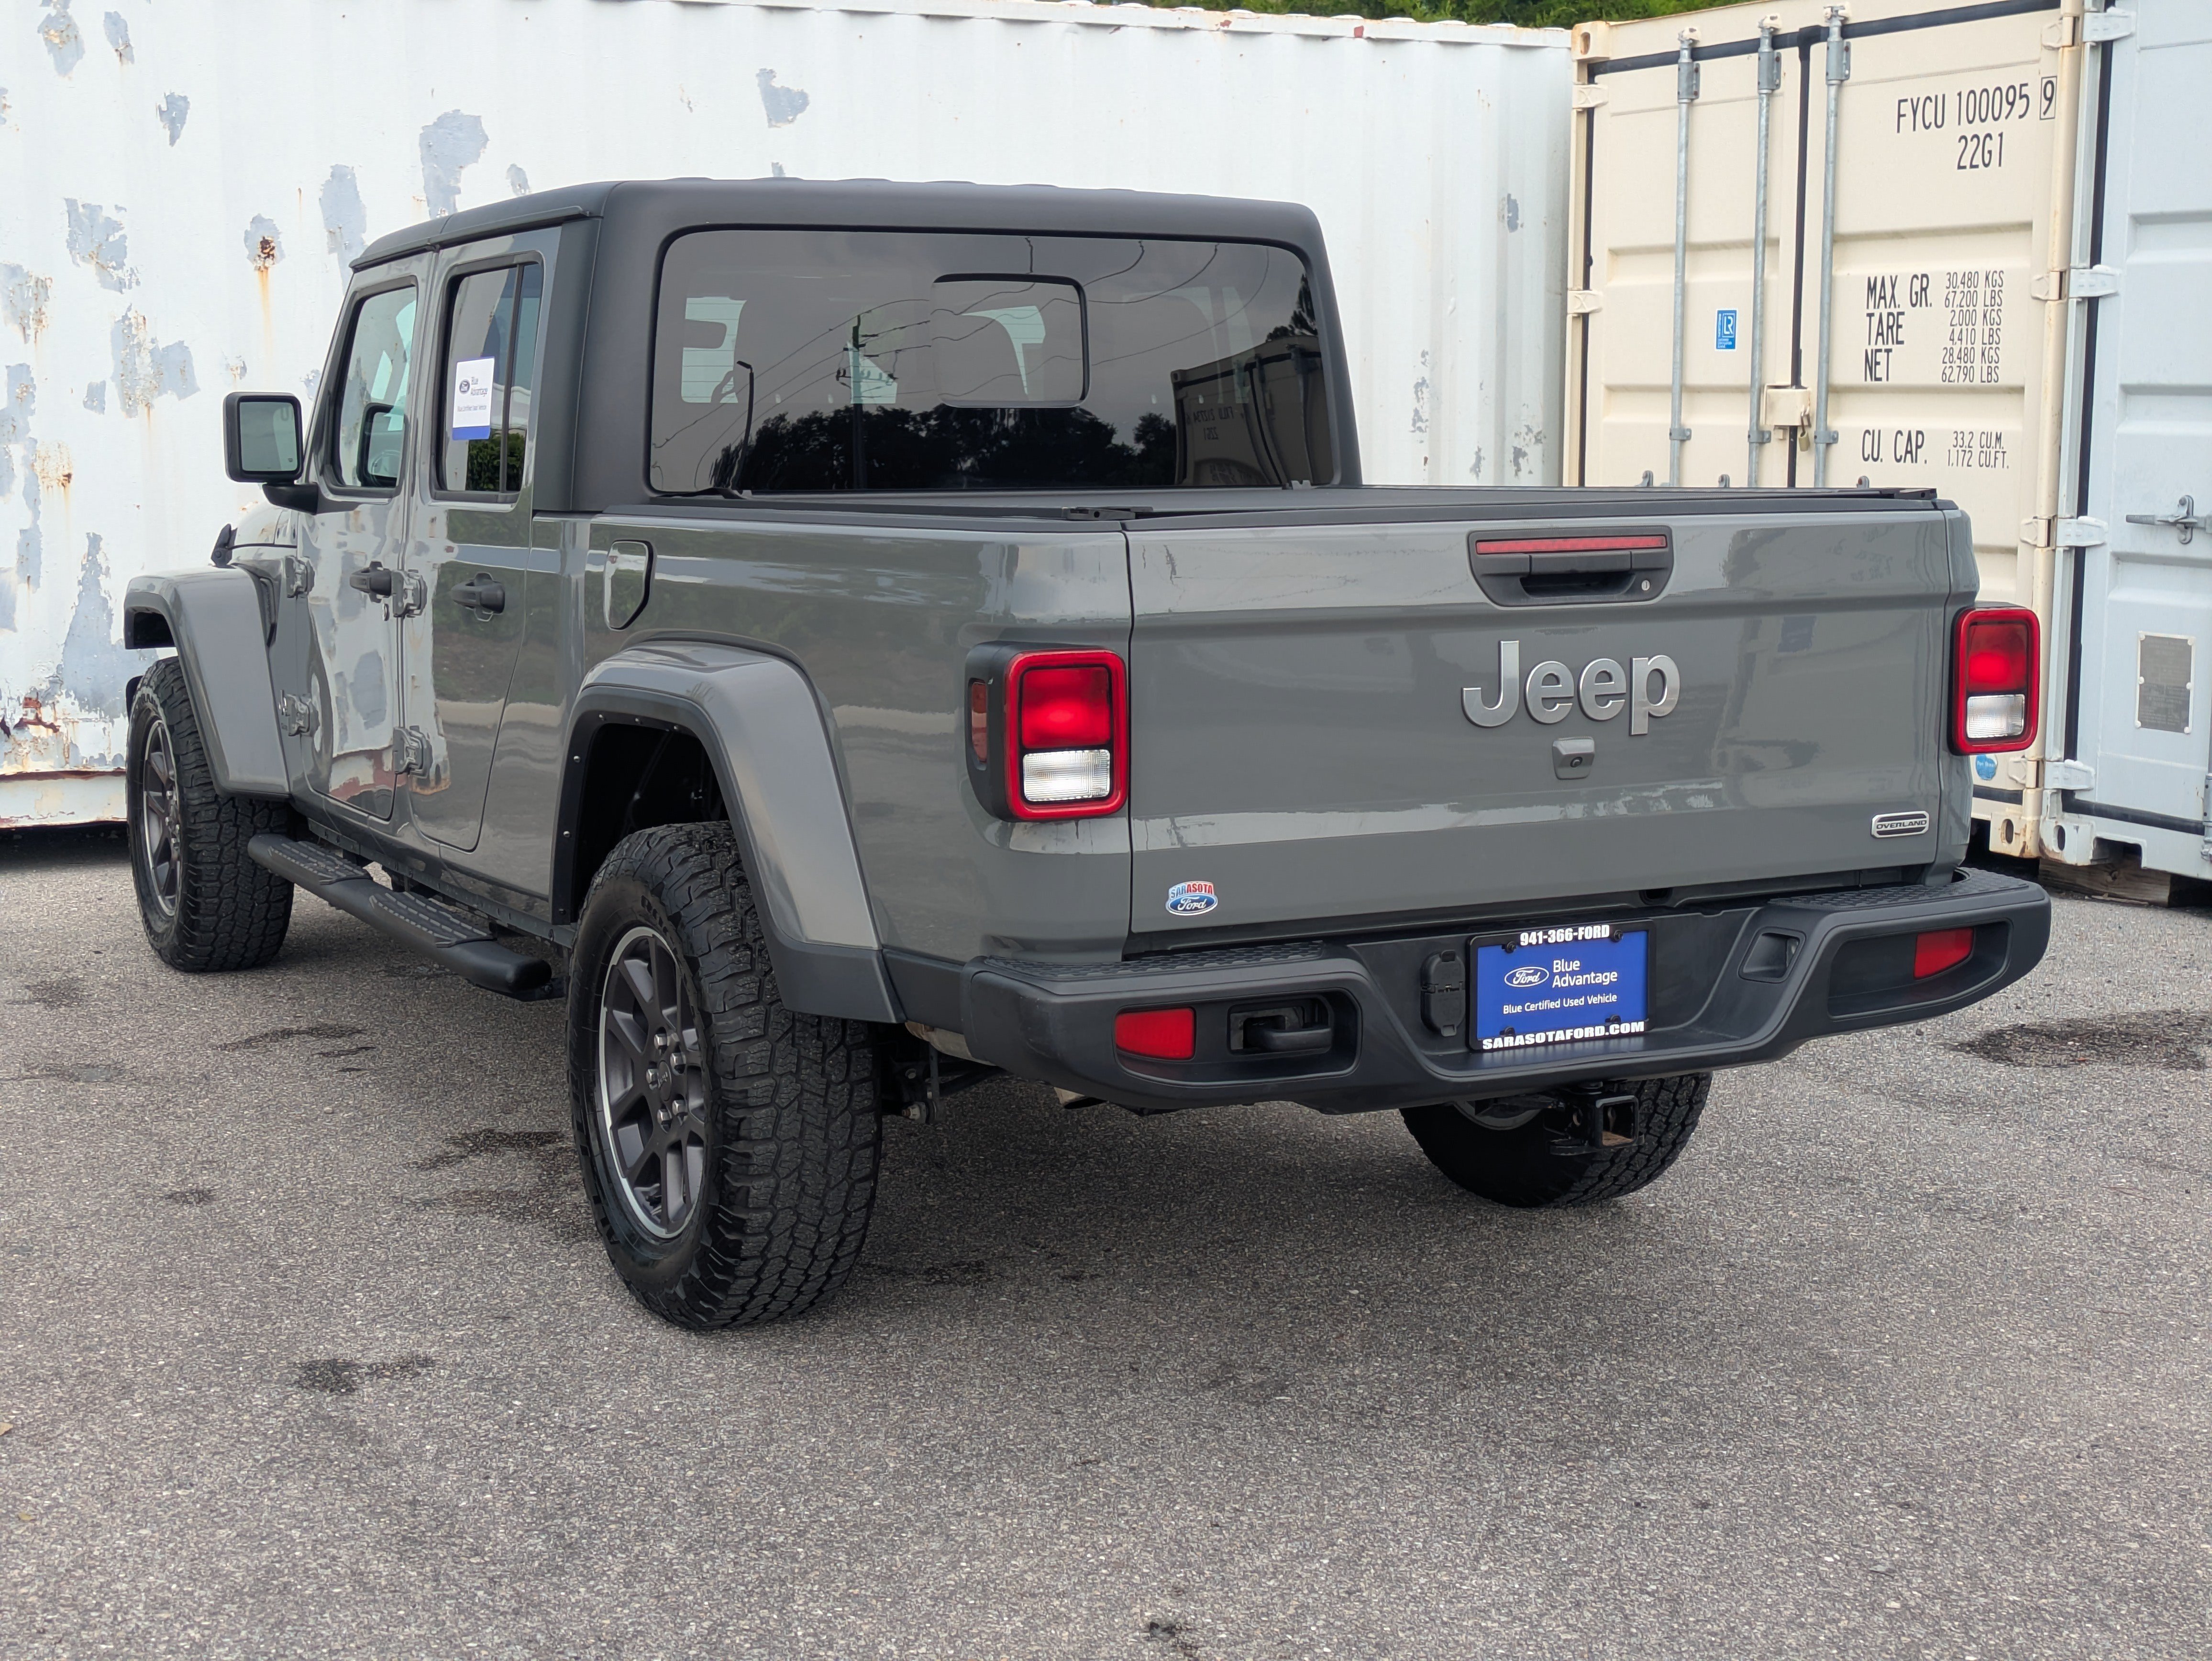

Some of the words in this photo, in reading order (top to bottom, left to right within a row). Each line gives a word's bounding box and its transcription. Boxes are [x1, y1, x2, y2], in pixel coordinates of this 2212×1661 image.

[1897, 93, 1946, 133] FYCU
[1957, 82, 2030, 126] 100095
[2042, 79, 2055, 116] 9
[1957, 132, 2003, 170] 22G1
[1866, 275, 1901, 310] MAX.
[1910, 273, 1932, 308] GR.
[1985, 270, 2004, 288] KGS
[1983, 289, 2003, 307] LBS
[1866, 311, 1905, 345] TARE
[1982, 308, 2002, 326] KGS
[1981, 327, 2001, 345] LBS
[1865, 348, 1892, 382] NET
[1980, 346, 2000, 365] KGS
[1980, 365, 1999, 383] LBS
[1862, 430, 1883, 463] CU.
[1894, 430, 1927, 464] CAP.
[1952, 431, 1974, 448] 33.2
[1980, 431, 2004, 449] CU.M.
[1979, 450, 2009, 469] CU.FT.
[1461, 640, 1681, 736] Jeep
[1876, 820, 1927, 830] OVERLAND
[1171, 883, 1213, 898] SARASOTA
[1178, 896, 1207, 910] Ford
[1520, 924, 1610, 946] 941-366-FORD
[1553, 958, 1581, 973] Blue
[1513, 970, 1541, 986] Ford
[1552, 970, 1618, 989] Advantage
[1503, 1005, 1523, 1014] Blue
[1525, 998, 1560, 1011] Certified
[1563, 996, 1585, 1008] Used
[1587, 993, 1617, 1004] Vehicle
[1482, 1021, 1645, 1050] SARASOTAFORD.COM
